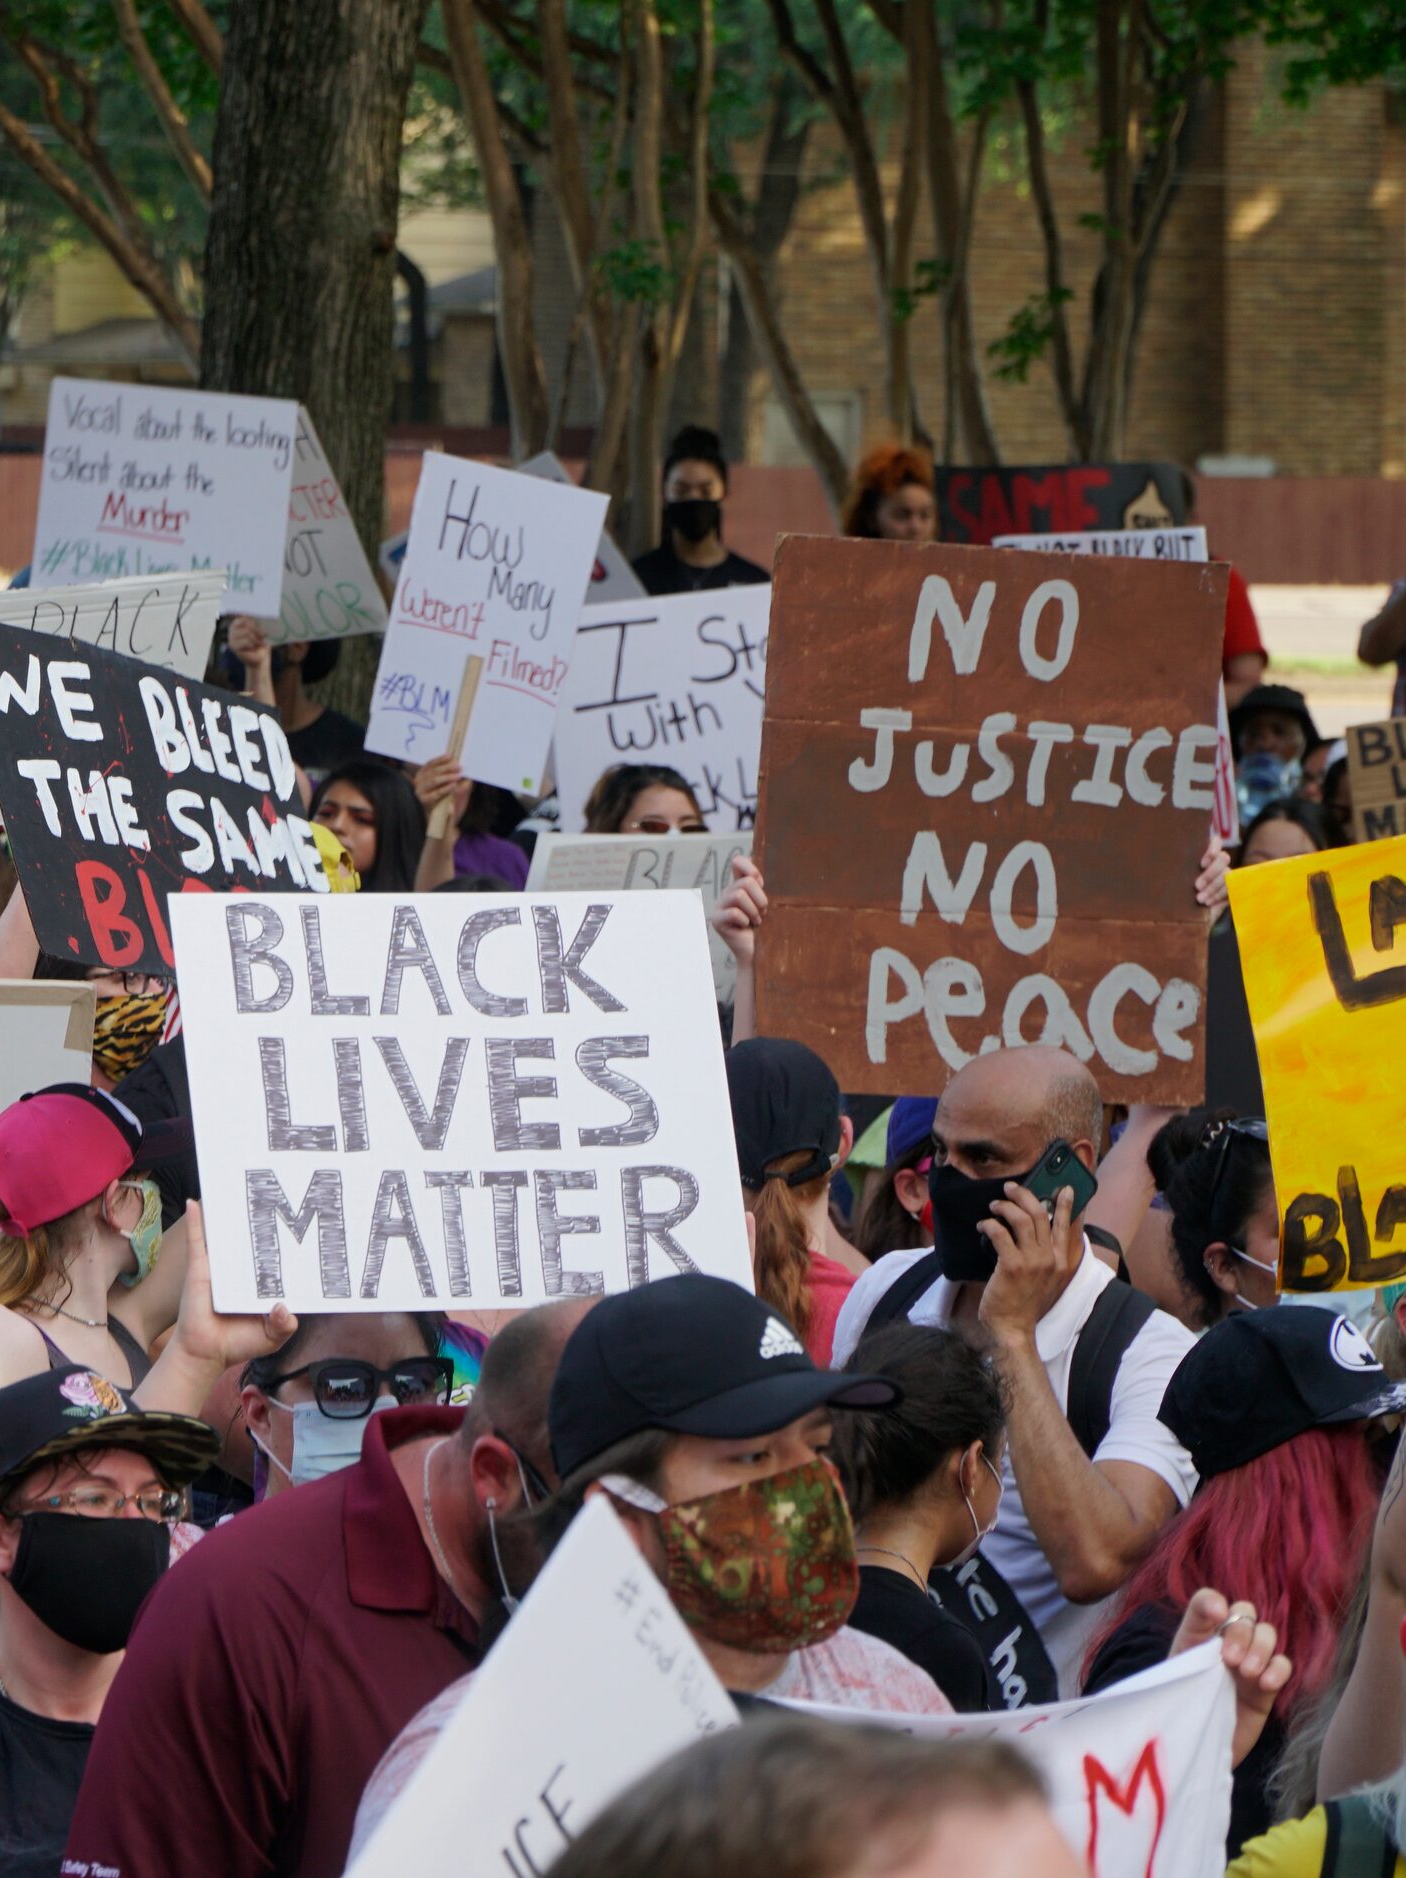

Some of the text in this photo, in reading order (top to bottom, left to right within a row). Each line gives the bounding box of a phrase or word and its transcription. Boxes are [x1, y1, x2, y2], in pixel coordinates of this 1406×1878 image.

[63, 393, 121, 437] Vocal
[134, 407, 183, 444] about
[194, 411, 217, 445] the
[226, 417, 291, 470] looting
[121, 461, 173, 493] about
[185, 461, 216, 494] the
[99, 492, 191, 535] Murder
[438, 480, 525, 568] How
[488, 566, 555, 641] Many
[908, 574, 1080, 682] NO
[380, 673, 451, 723] #BLM
[486, 640, 568, 696] Filmed?
[574, 617, 660, 712] I
[139, 677, 296, 801] BLEED
[17, 760, 150, 851] THE
[166, 788, 331, 893] SAME
[899, 830, 1058, 955] NO
[225, 902, 629, 1017] BLACK
[258, 1035, 661, 1153] LIVES
[245, 1164, 701, 1300] MATTER
